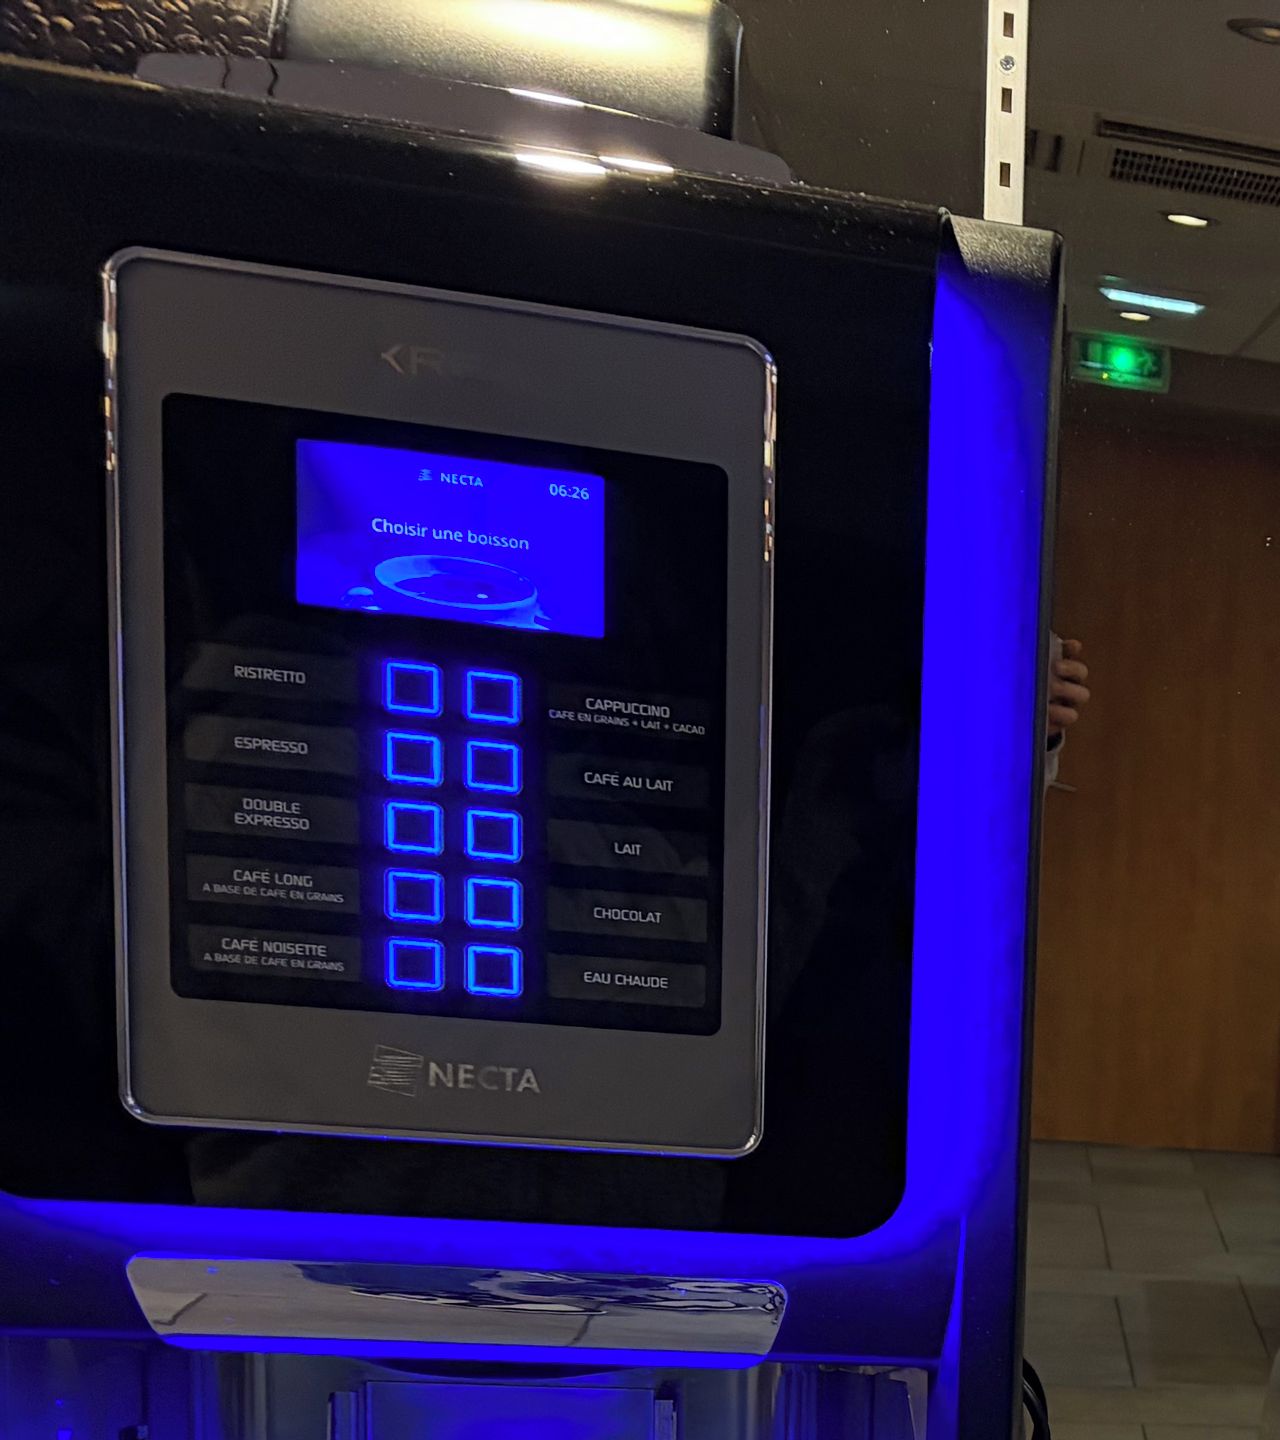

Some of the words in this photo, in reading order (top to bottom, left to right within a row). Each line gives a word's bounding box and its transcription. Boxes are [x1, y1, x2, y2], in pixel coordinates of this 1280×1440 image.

[440, 471, 484, 488] NECTA
[548, 482, 591, 501] 06:26
[371, 518, 427, 538] Choisir
[432, 527, 463, 543] une
[467, 530, 530, 551] boisson
[234, 665, 306, 684] RISTRETTO
[585, 697, 670, 718] CAPPUCCINO
[672, 723, 706, 736] CACAO
[234, 736, 308, 755] ESPRESSO
[623, 776, 643, 789] AU
[646, 778, 674, 793] LAIT
[242, 797, 301, 814] DOUBLE
[234, 812, 310, 831] EXPRESSO
[614, 841, 642, 856] LAIT
[275, 873, 313, 887] LONG
[593, 906, 662, 924] CHOCOLAT
[263, 941, 327, 957] NOISETTE
[584, 971, 611, 985] EAU
[615, 974, 669, 989] CHAUDE
[428, 1062, 541, 1093] NECTA
